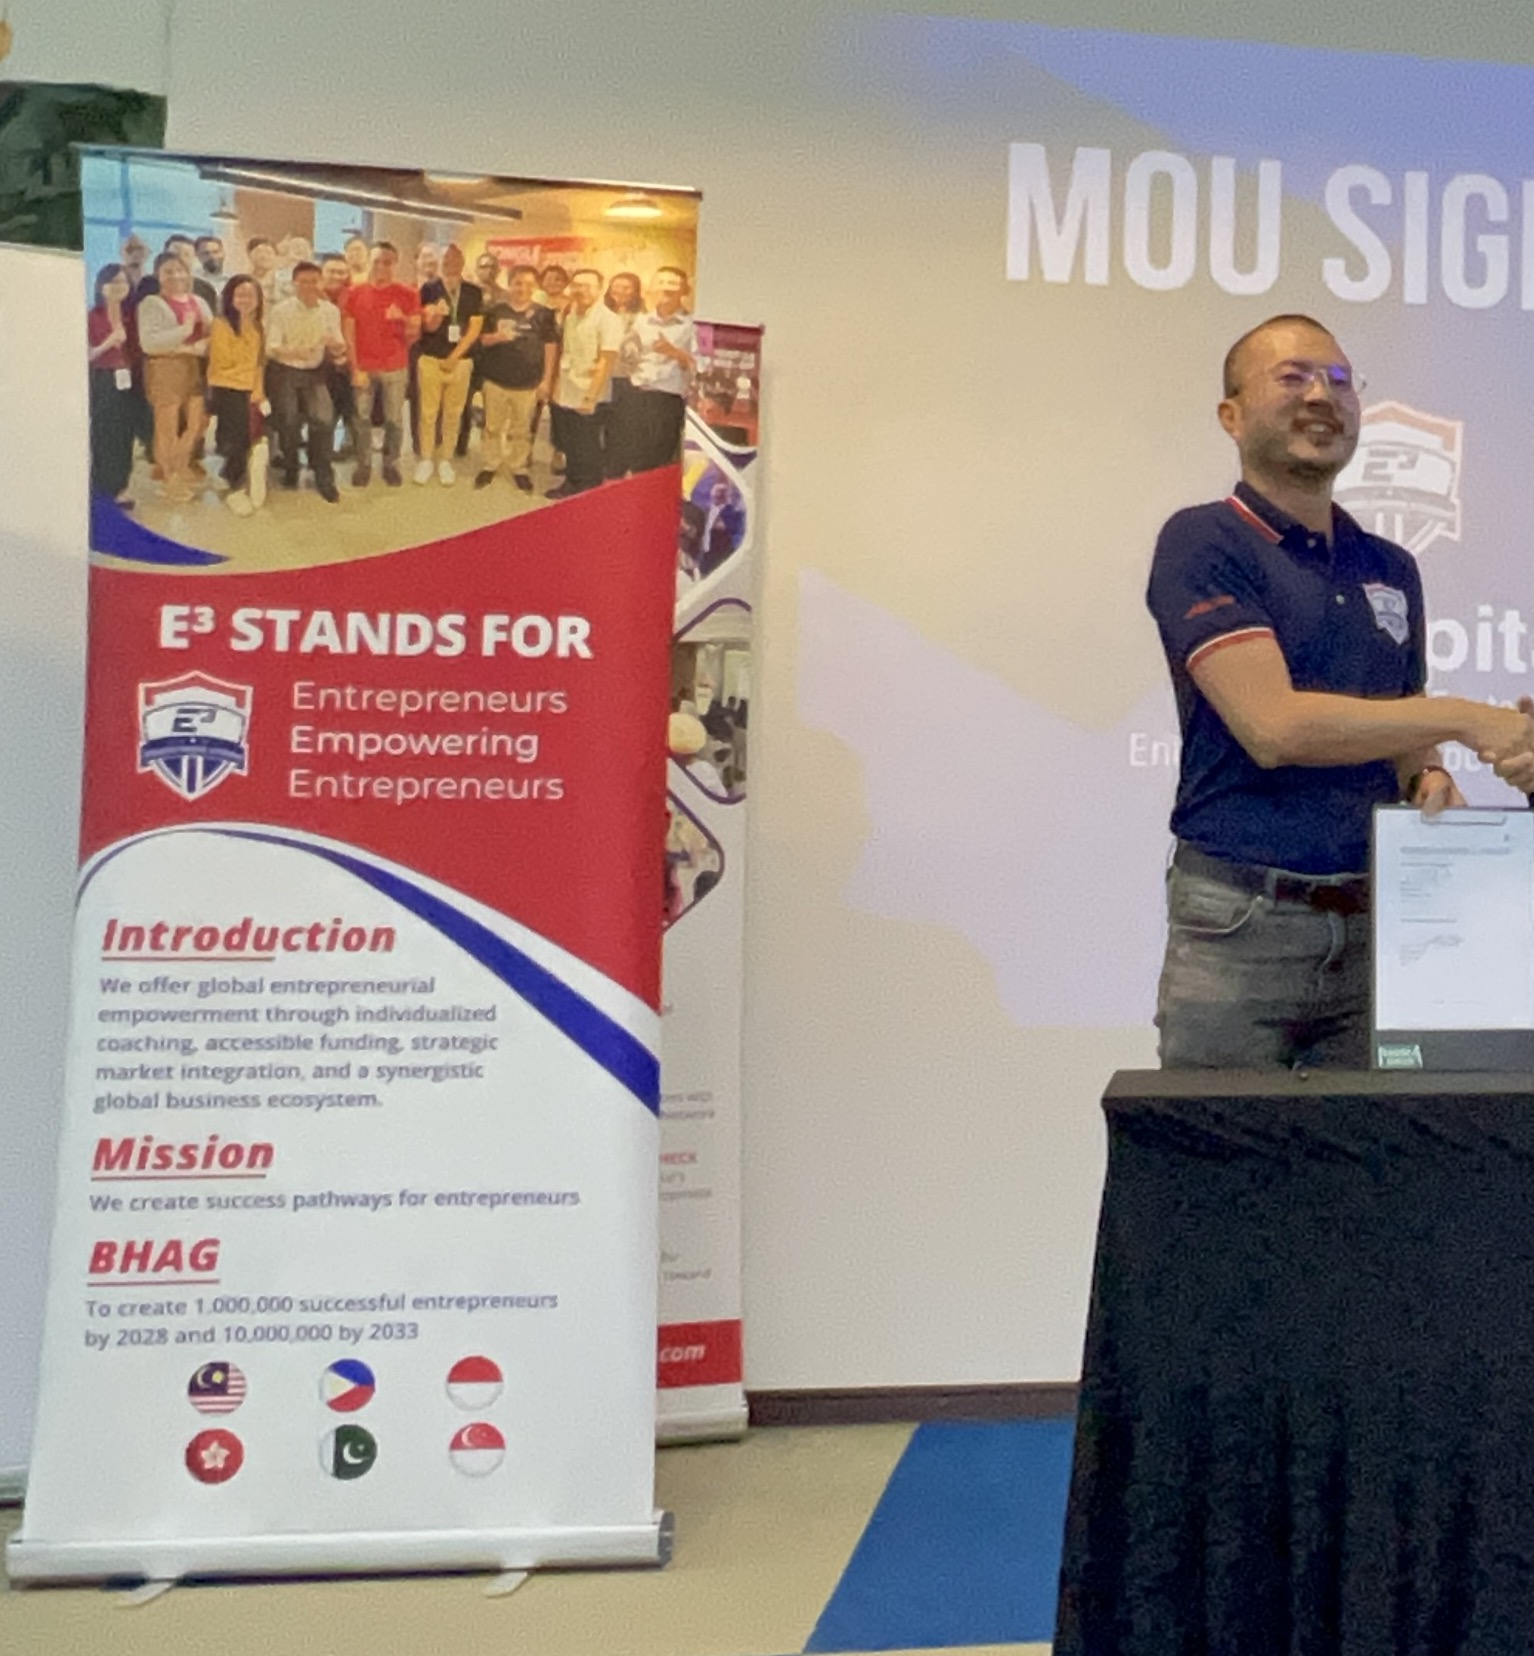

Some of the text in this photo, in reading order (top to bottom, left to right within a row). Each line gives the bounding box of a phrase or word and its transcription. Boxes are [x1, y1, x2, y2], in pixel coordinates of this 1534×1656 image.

[1006, 141, 1283, 295] MOU
[230, 608, 467, 657] STANDS
[482, 614, 593, 660] FOR
[293, 682, 568, 717] Entrepreneurs
[291, 725, 539, 763] Empowering
[288, 768, 564, 805] Entrepreneurs
[101, 917, 396, 953] Introduction
[100, 977, 435, 998] We offer global entrepreneurial
[98, 1006, 496, 1025] empowerment through individualized
[97, 1033, 498, 1054] coaching, accessible funding, strategic
[96, 1063, 173, 1081] market
[312, 1062, 350, 1080] and
[358, 1066, 369, 1080] a
[375, 1062, 483, 1083] synergistic
[93, 1092, 158, 1113] global
[166, 1092, 261, 1109] business
[93, 1134, 273, 1171] Mission
[90, 1190, 580, 1212] We create success pathways for entrepreneurs
[88, 1238, 220, 1275] BHAG
[87, 1299, 111, 1318] To
[118, 1299, 187, 1317] create
[299, 1293, 406, 1313] successful
[412, 1291, 558, 1313] entrepreneurs
[84, 1331, 109, 1349] by
[117, 1328, 168, 1346] 2028
[175, 1327, 214, 1345] and
[339, 1324, 363, 1344] by
[370, 1322, 419, 1340] 2033
